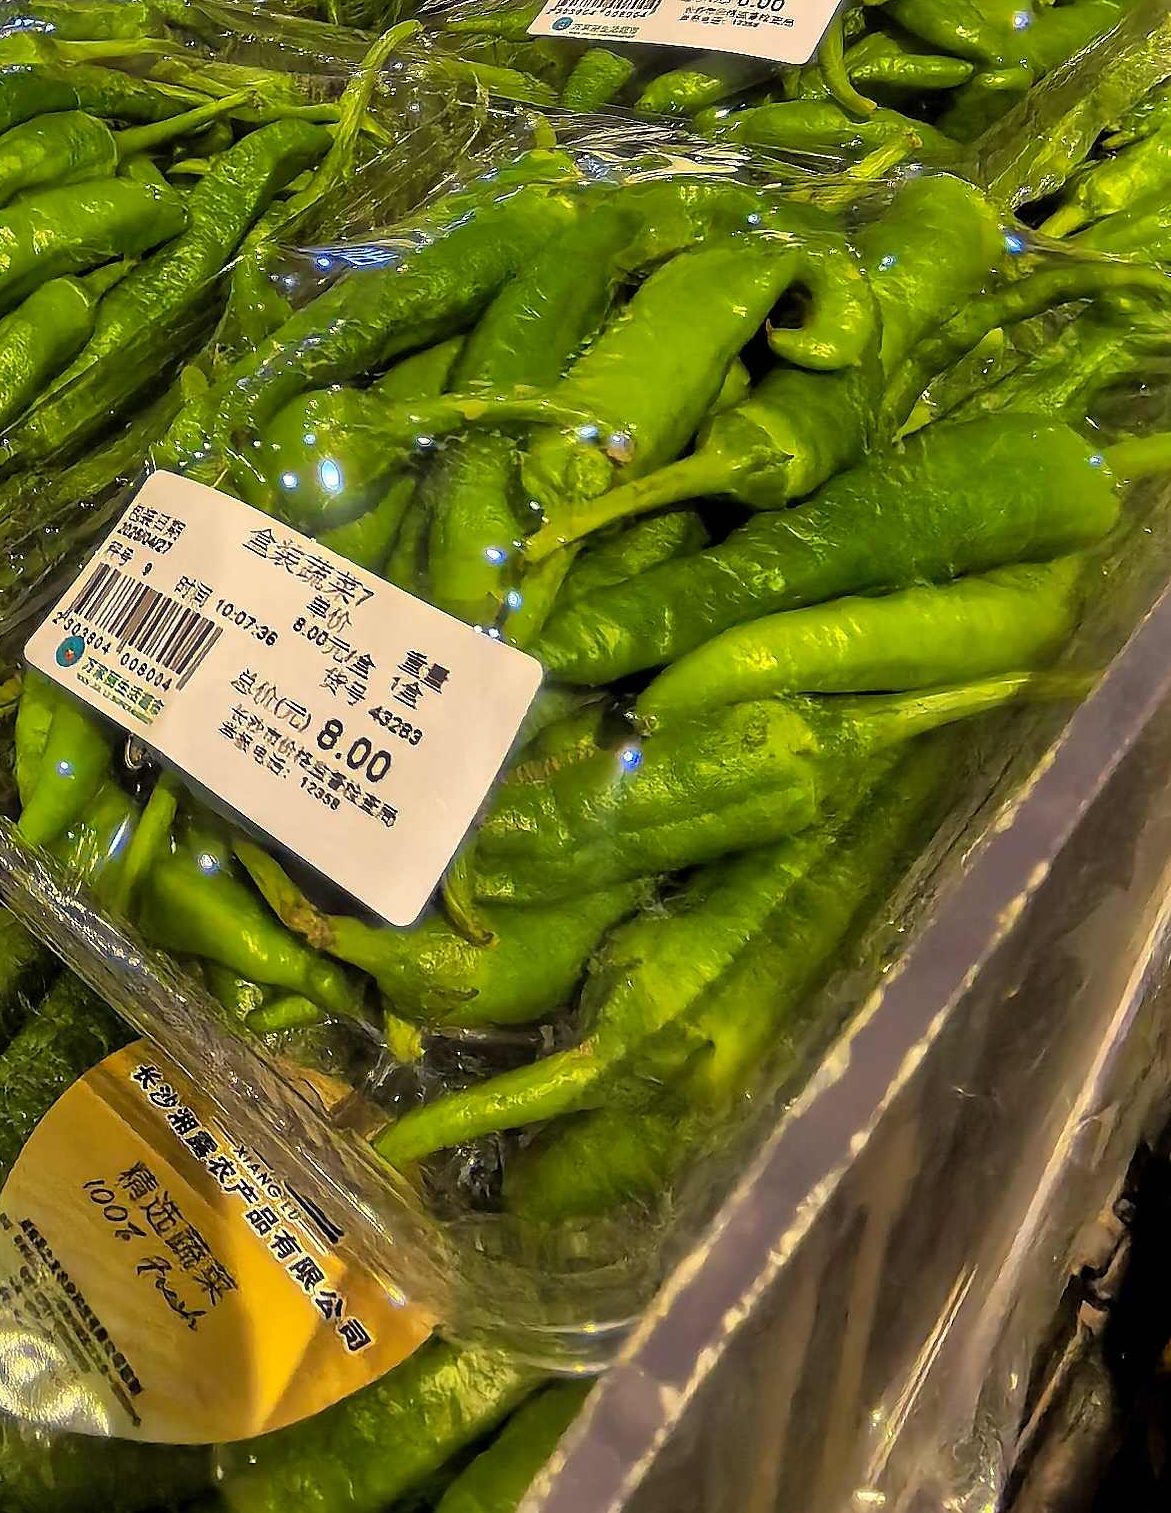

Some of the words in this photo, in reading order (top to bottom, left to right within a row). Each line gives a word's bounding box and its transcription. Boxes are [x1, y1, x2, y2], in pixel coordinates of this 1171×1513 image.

[241, 528, 375, 607] 盒装蔬菜7
[214, 597, 279, 647] 10:07:36
[306, 594, 353, 633] 单价
[291, 616, 377, 680] 8.00元/盒
[397, 649, 451, 695] 重量
[318, 666, 367, 707] 货号
[367, 705, 424, 746] 43283
[390, 676, 424, 710] 1盒
[229, 668, 312, 733] 总价(元)
[316, 717, 393, 784] 8.00
[299, 775, 341, 811] 12358
